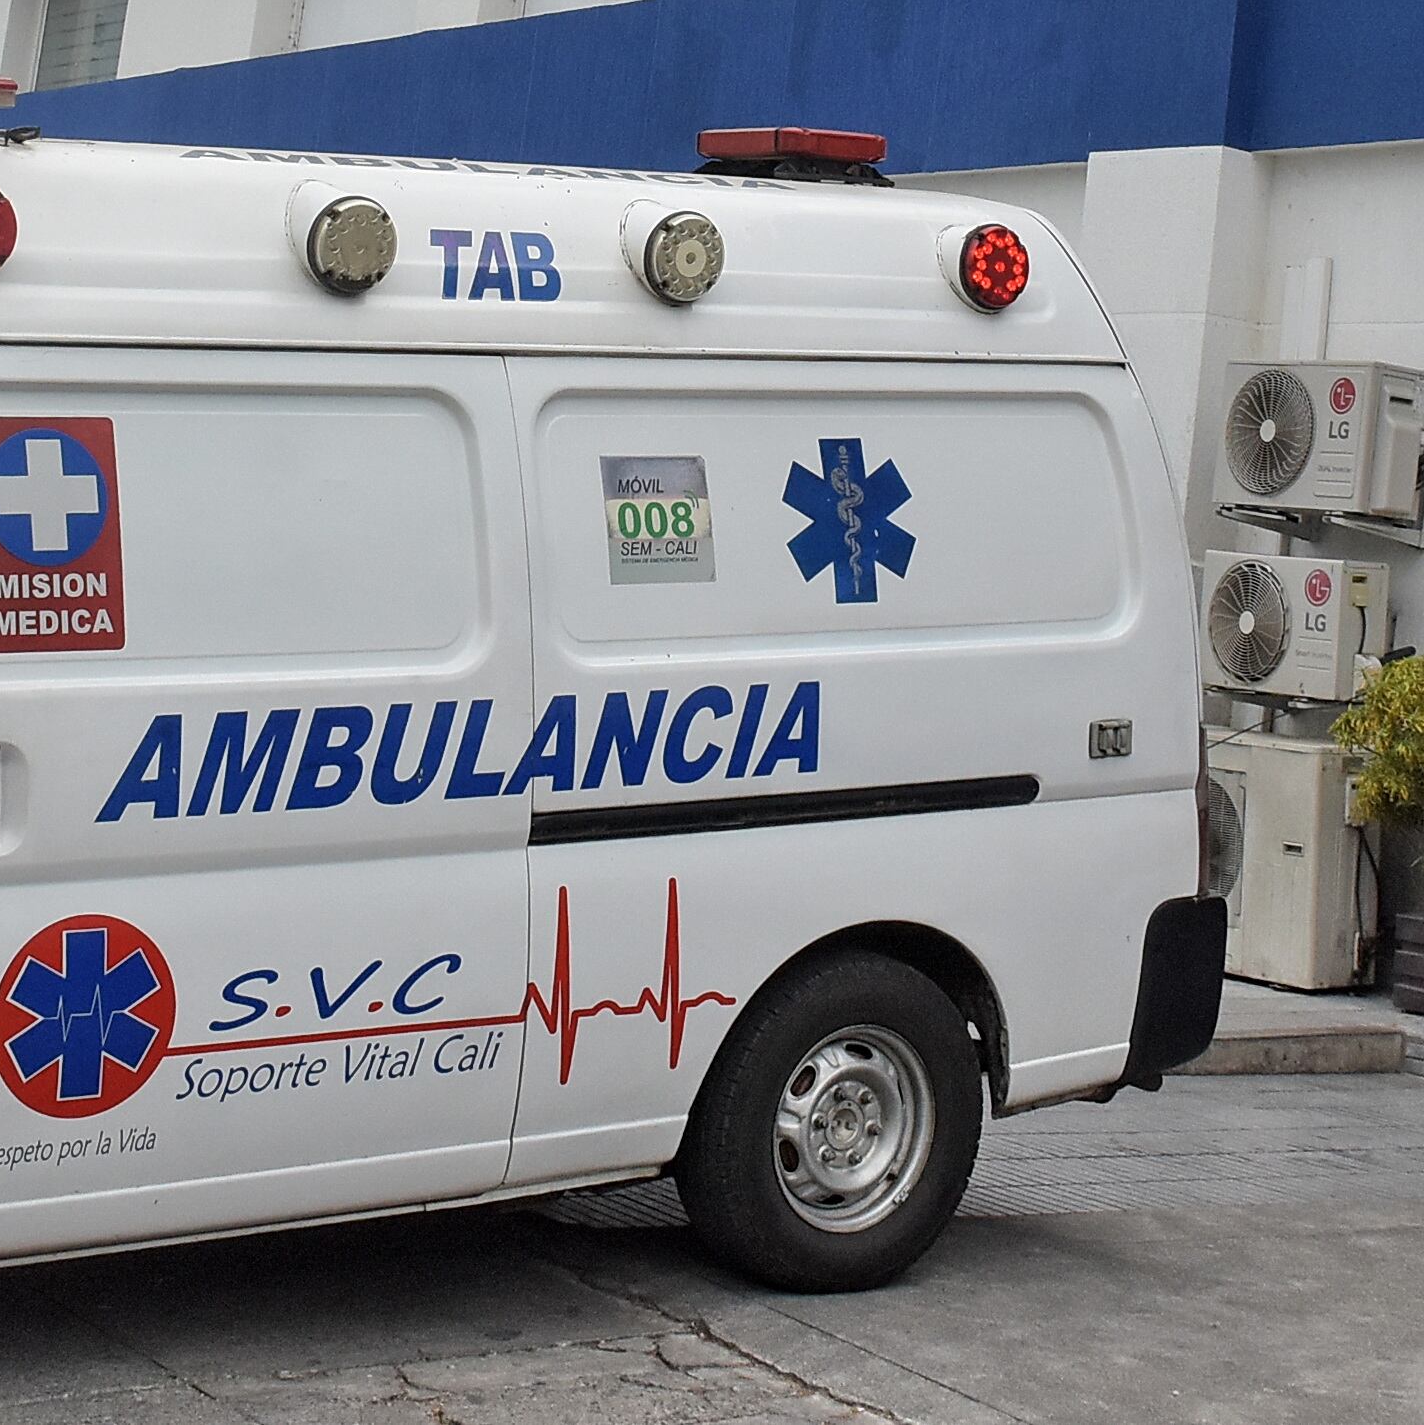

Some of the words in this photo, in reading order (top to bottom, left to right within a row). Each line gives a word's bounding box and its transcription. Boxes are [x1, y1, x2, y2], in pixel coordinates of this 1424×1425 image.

[178, 149, 797, 191] AMBULANCIA
[429, 229, 562, 303] TAB
[1328, 420, 1350, 439] LG
[617, 475, 664, 493] MÓVIL
[617, 501, 695, 539] 008
[620, 541, 652, 556] SEM
[665, 540, 698, 555] CALI
[1304, 612, 1326, 632] LG
[93, 680, 823, 823] AMBULANCIA
[175, 1054, 328, 1103] Soporte
[341, 1035, 424, 1085] Vital
[433, 1031, 505, 1075] Cali
[56, 1139, 93, 1167] por
[94, 1130, 112, 1157] la
[117, 1126, 157, 1155] Vida
